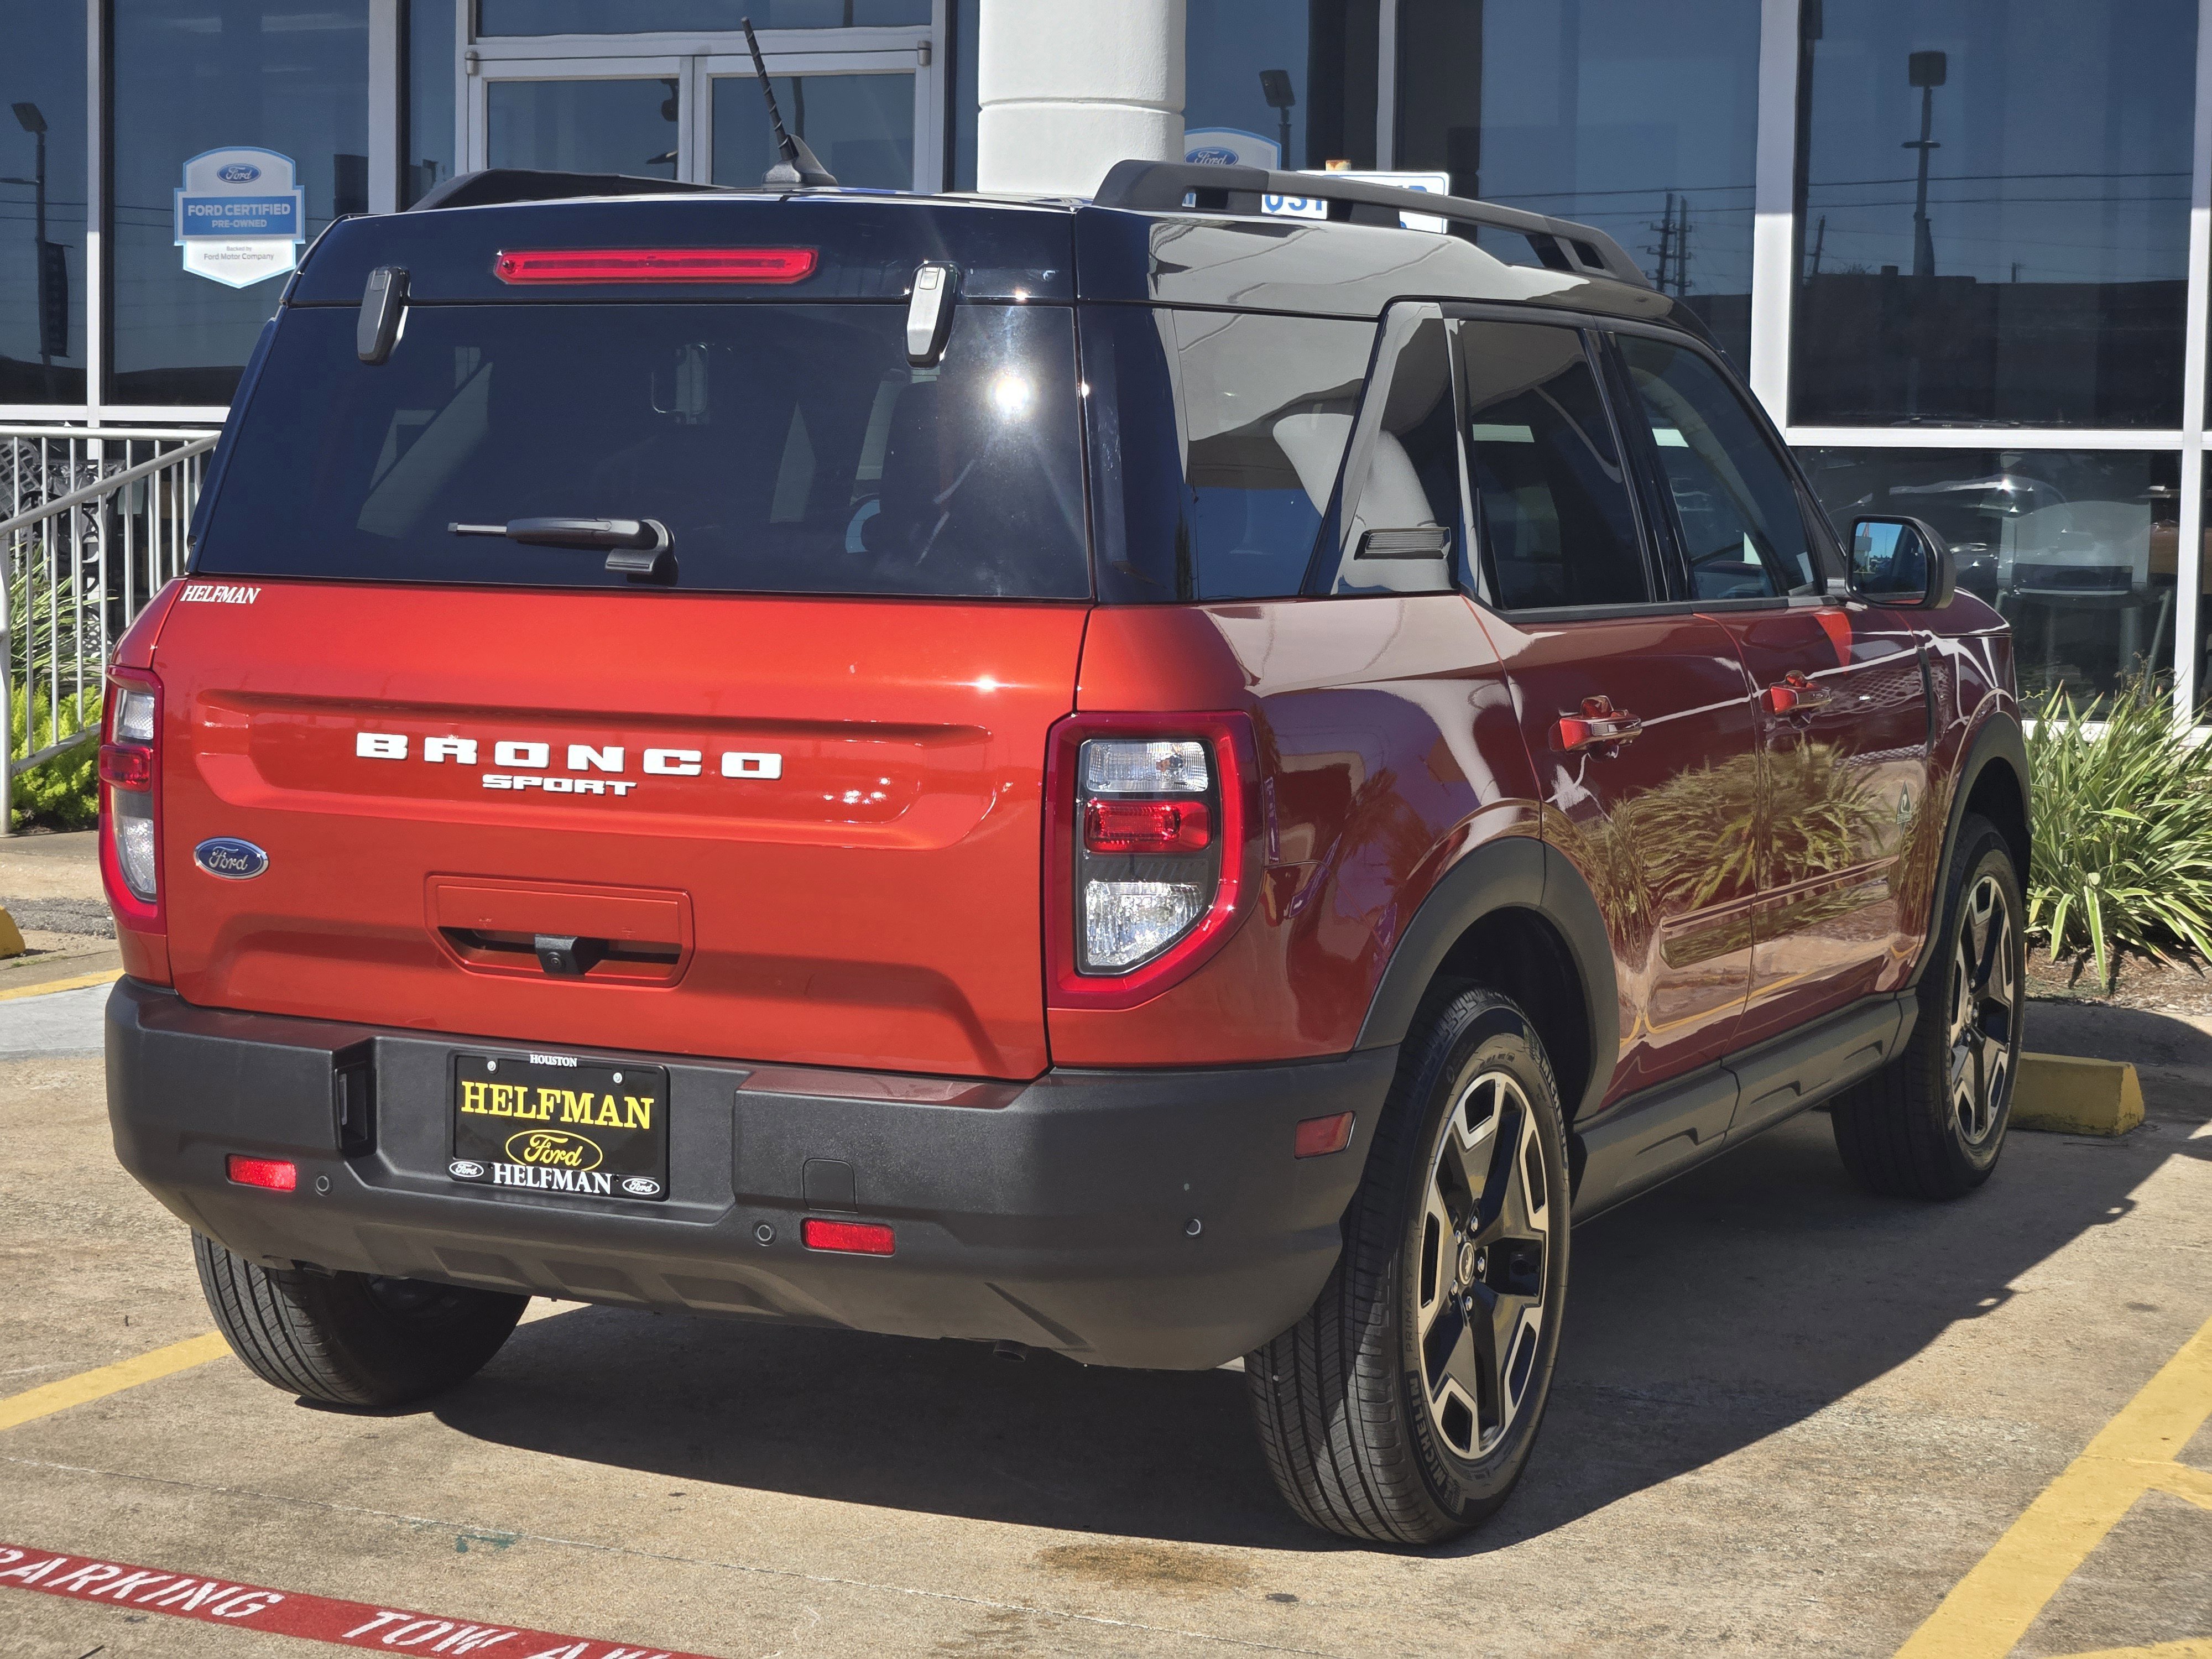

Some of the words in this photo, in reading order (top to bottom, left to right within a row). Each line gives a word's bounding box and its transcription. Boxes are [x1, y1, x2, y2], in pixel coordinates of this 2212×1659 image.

[1194, 151, 1227, 165] Ford
[226, 167, 252, 180] Ford
[187, 205, 222, 216] FORD
[225, 204, 291, 216] CERTIFIED
[212, 220, 267, 228] PRE-OWNED
[180, 585, 262, 604] HELFMAN
[356, 732, 782, 780] BRONCO
[482, 774, 637, 796] SPORT
[208, 846, 249, 870] Ford
[529, 1054, 578, 1067] HOUSTON
[461, 1081, 654, 1129] HELFMAN
[524, 1134, 583, 1167] Ford
[455, 1164, 478, 1175] Ford
[493, 1162, 613, 1194] HELFMAN
[629, 1178, 653, 1193] Ford
[1410, 1377, 1448, 1486] MICHELIN
[0, 1548, 285, 1618] PARKING
[342, 1611, 518, 1655] TOW
